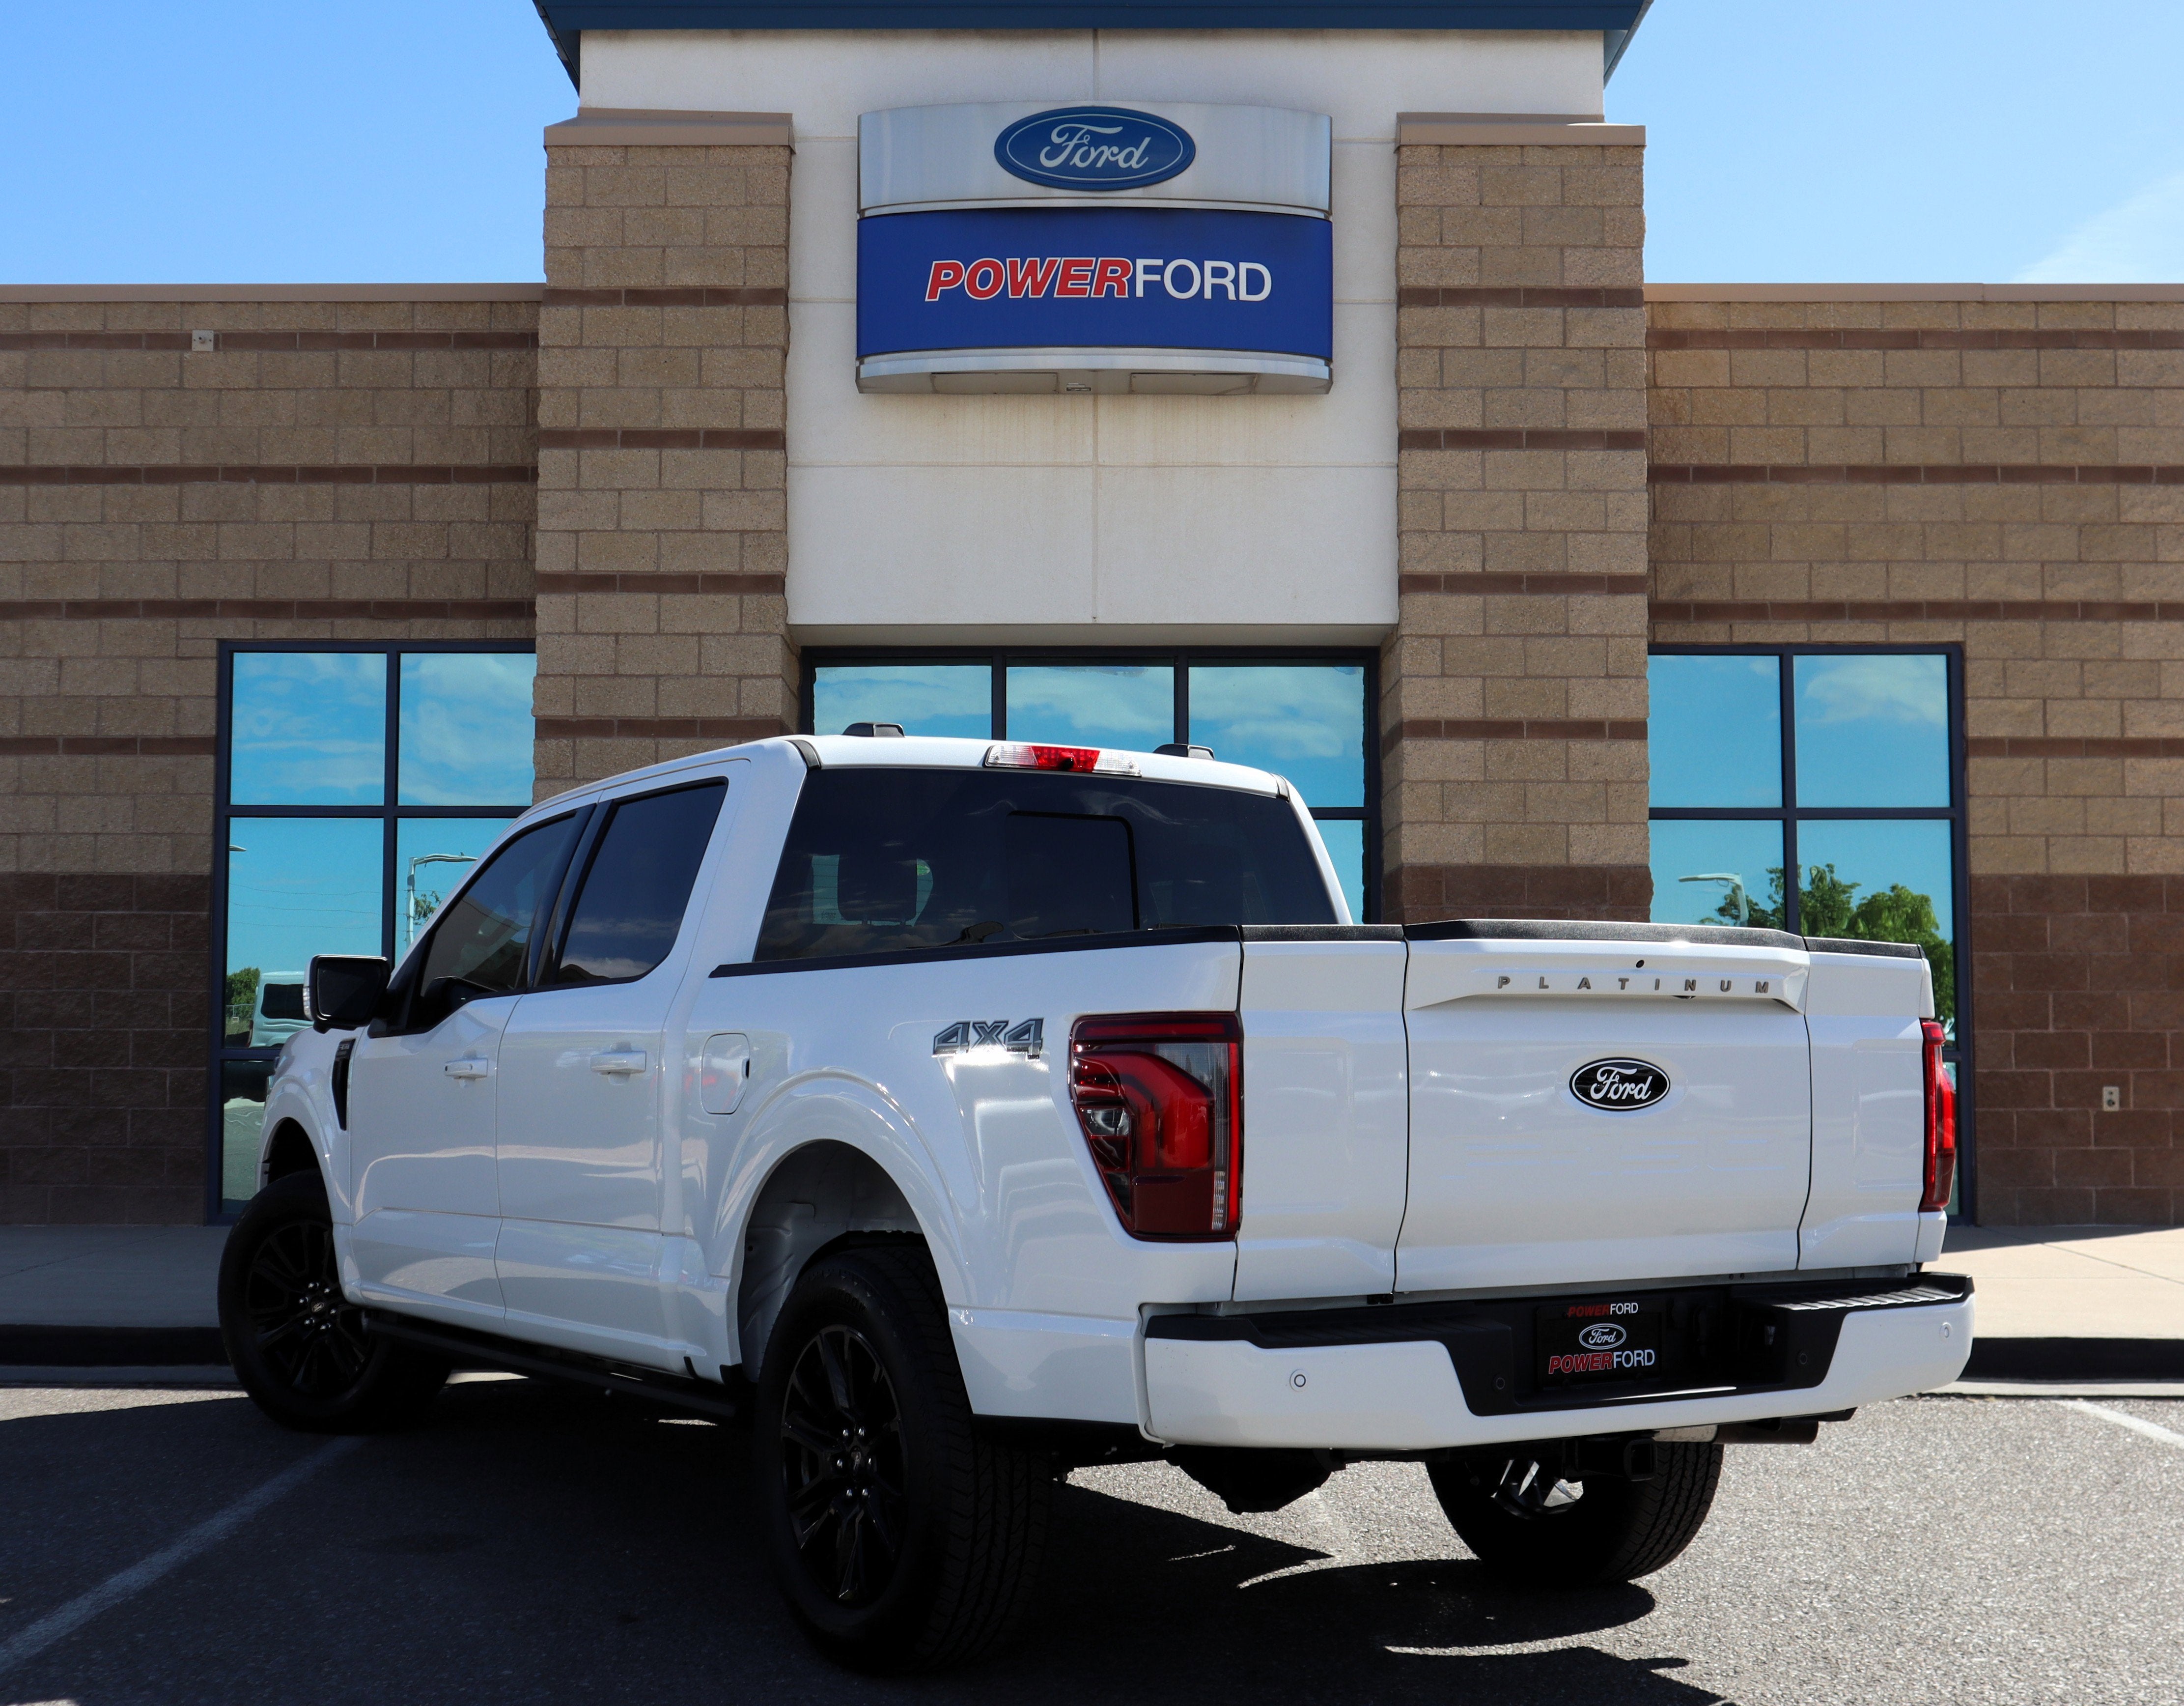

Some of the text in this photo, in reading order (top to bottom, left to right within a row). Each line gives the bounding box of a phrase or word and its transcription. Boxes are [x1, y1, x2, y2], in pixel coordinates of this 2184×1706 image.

[1040, 124, 1151, 169] Ford
[925, 257, 1272, 302] POWERFORD
[1498, 976, 1769, 994] PLATINUM
[1590, 1066, 1652, 1100] Ford
[1568, 1303, 1639, 1317] POWERFORD
[1589, 1328, 1616, 1344] Ford
[1548, 1349, 1655, 1374] POWERFORD
